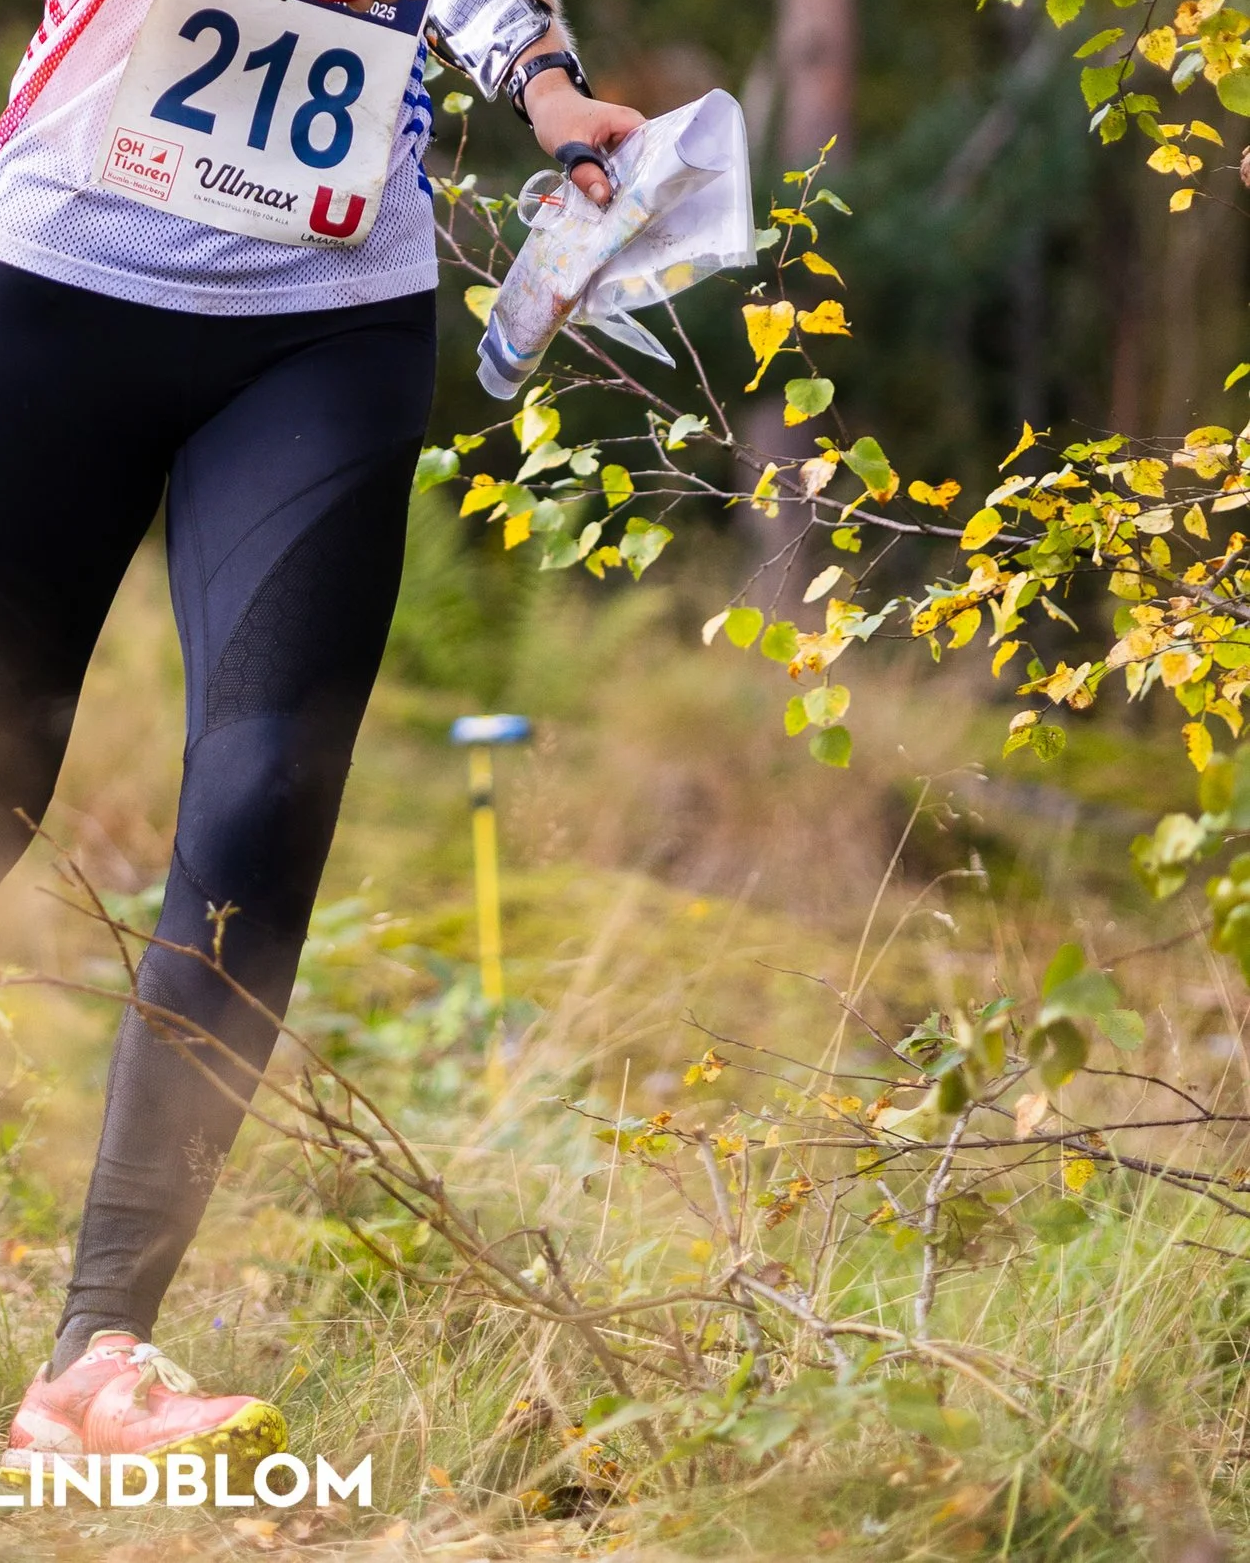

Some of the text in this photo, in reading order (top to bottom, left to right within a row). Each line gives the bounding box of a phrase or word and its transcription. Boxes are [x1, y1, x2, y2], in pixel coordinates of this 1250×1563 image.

[366, 1, 397, 21] 025
[150, 8, 365, 169] 218
[115, 152, 171, 184] Tisaren
[195, 157, 299, 212] Ullmax
